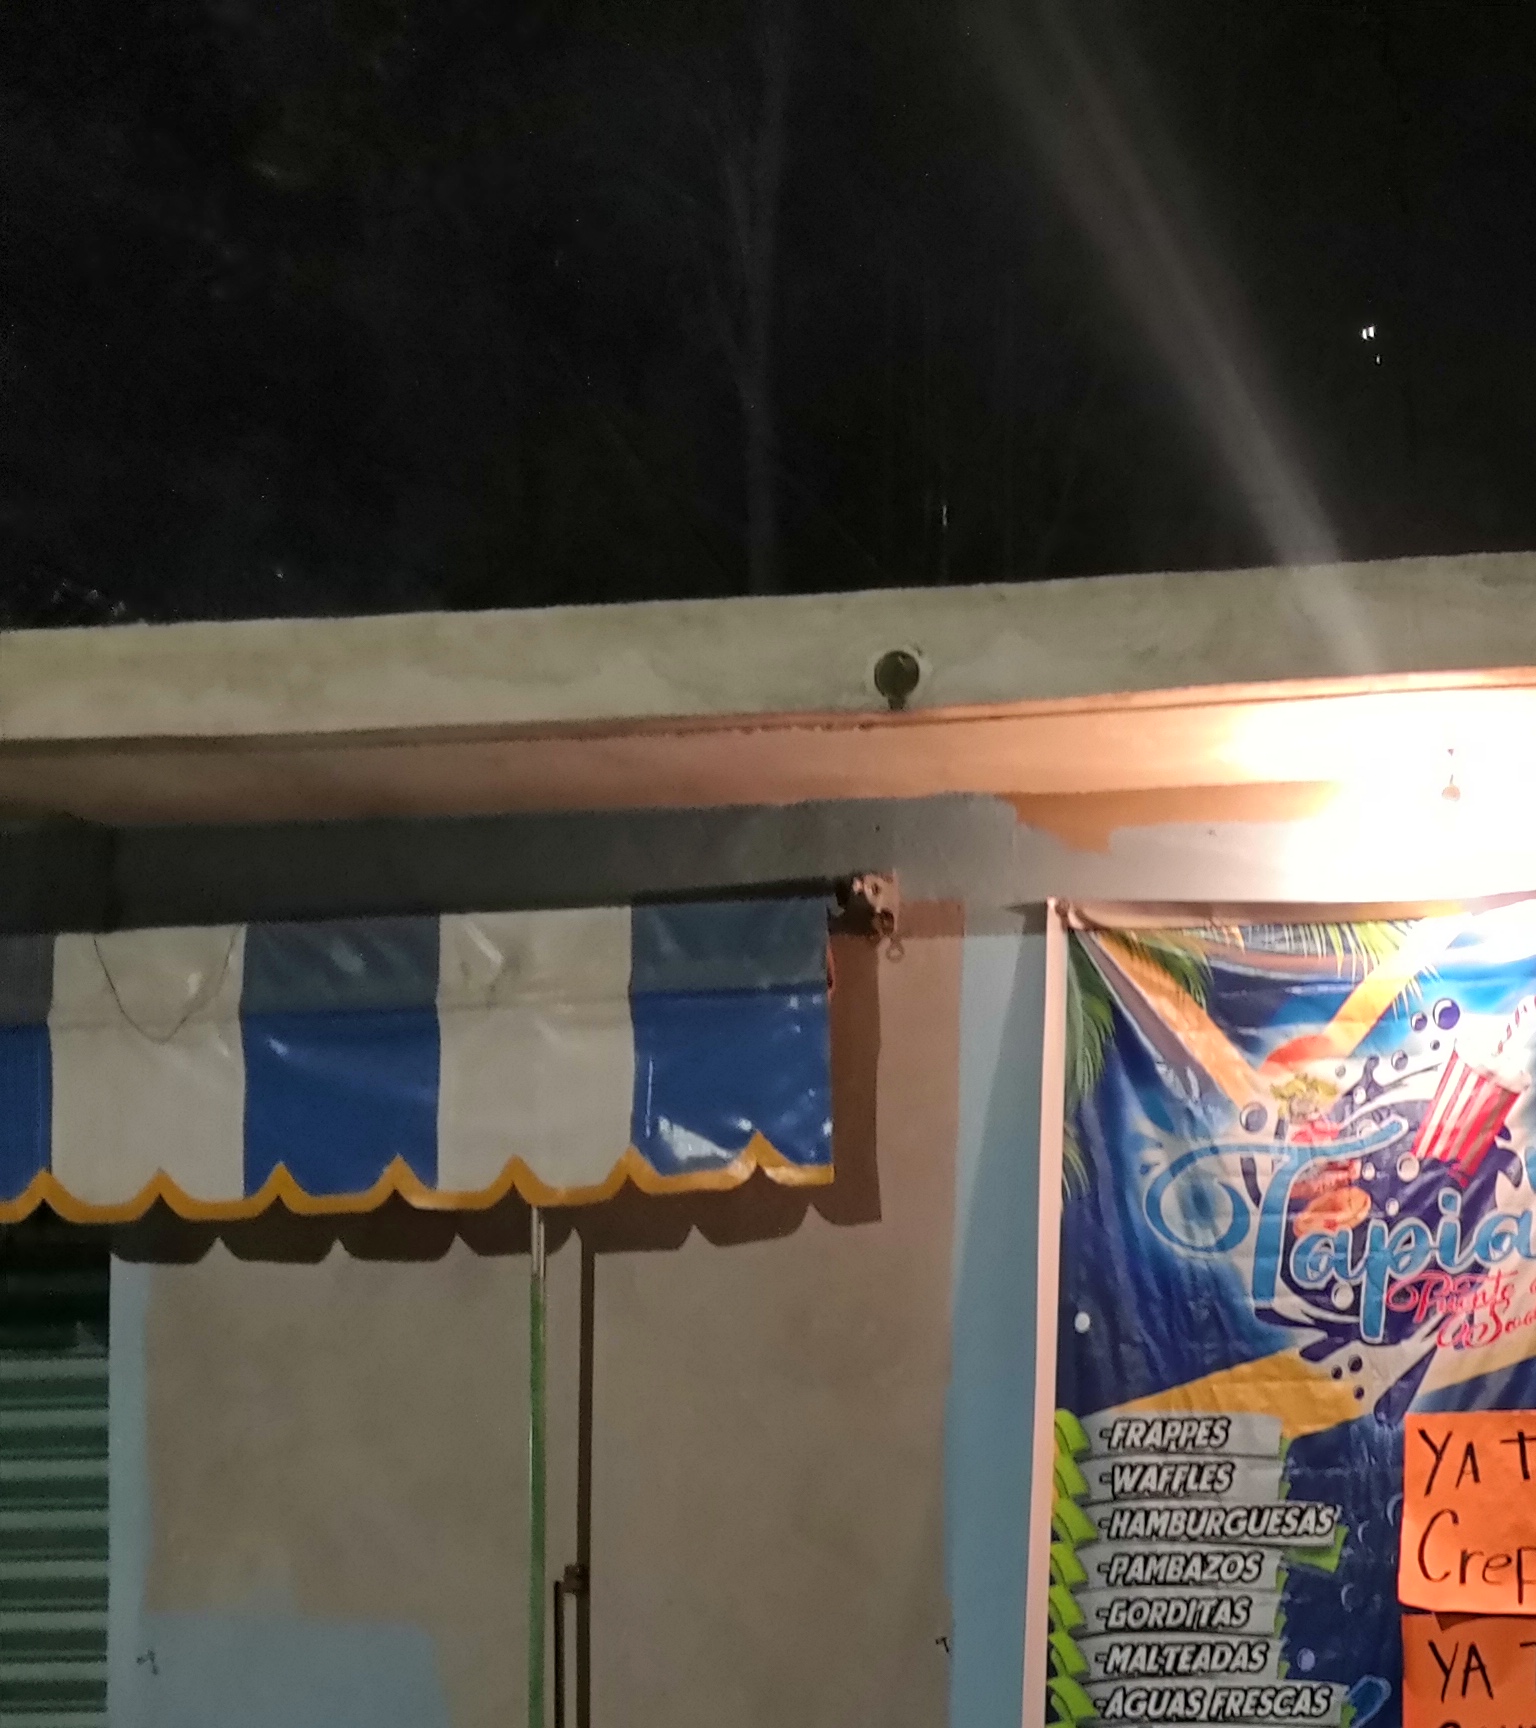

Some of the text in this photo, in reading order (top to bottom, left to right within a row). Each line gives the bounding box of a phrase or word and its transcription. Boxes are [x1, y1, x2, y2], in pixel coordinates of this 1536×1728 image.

[1417, 1428, 1481, 1498] YA
[1209, 1684, 1333, 1720] FRESCAS
[1427, 1639, 1494, 1703] YA
